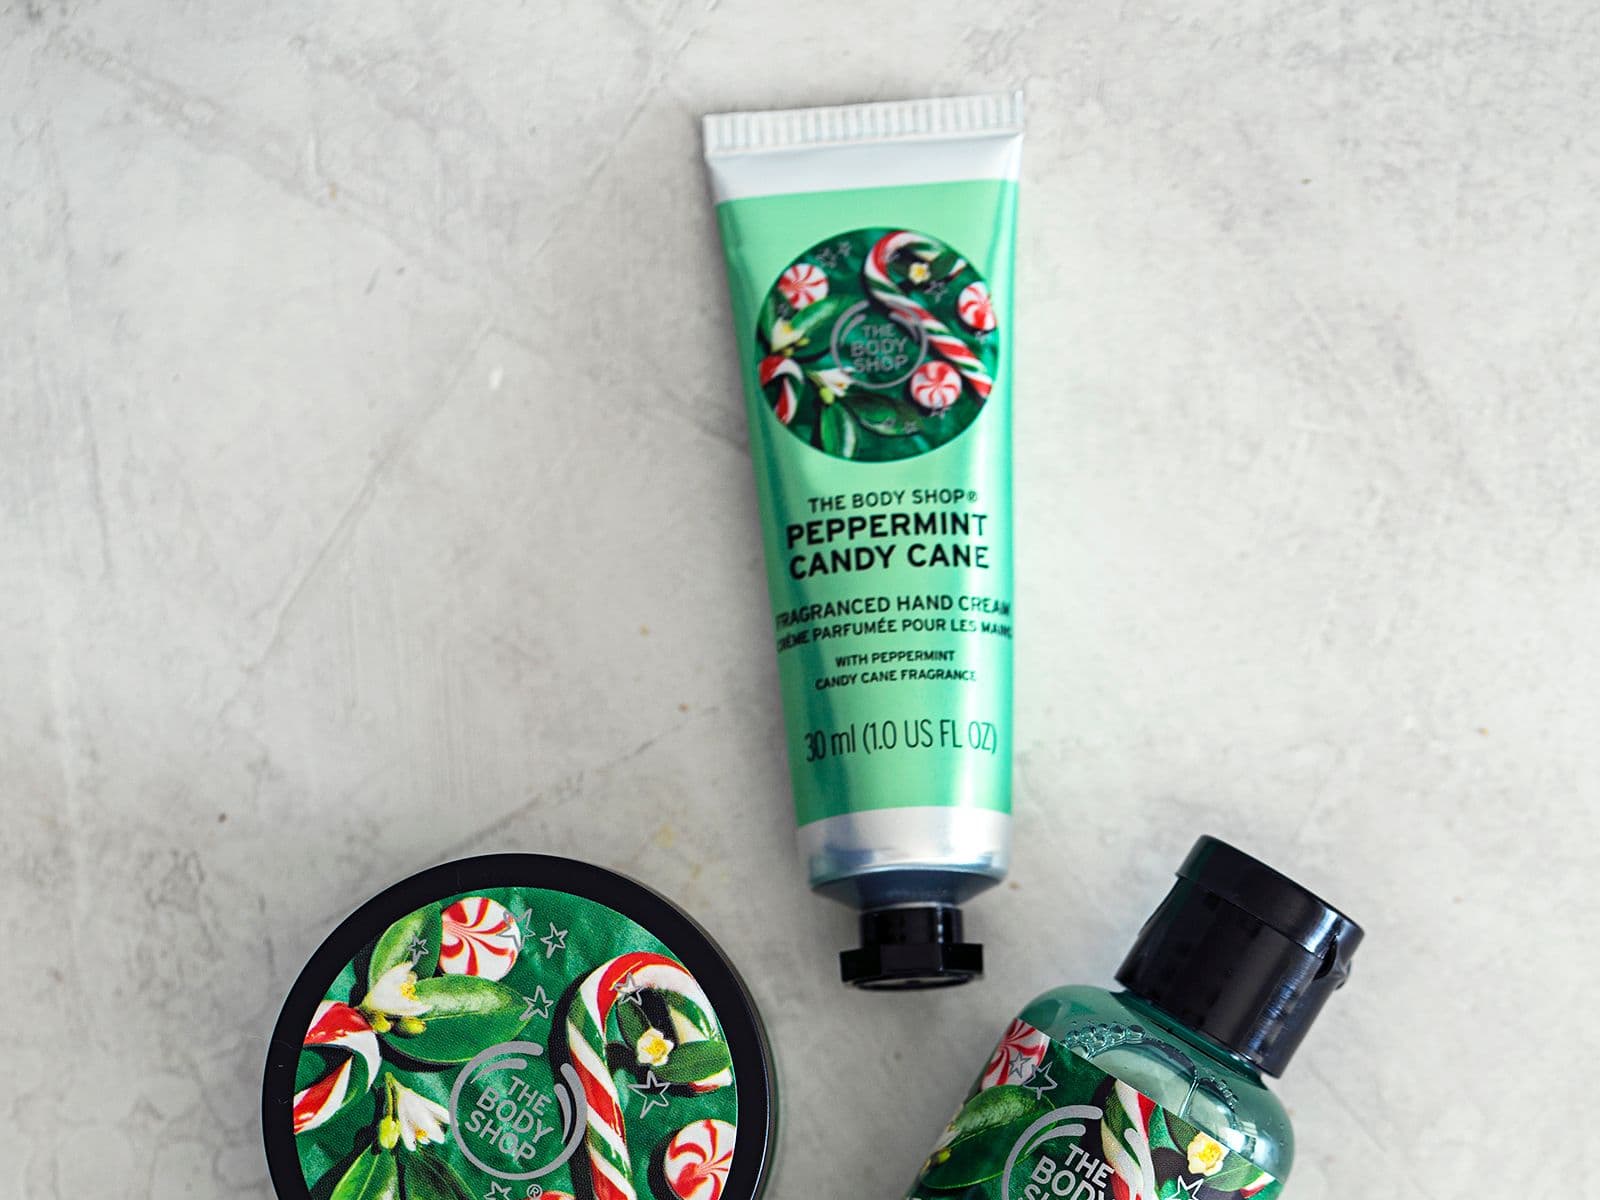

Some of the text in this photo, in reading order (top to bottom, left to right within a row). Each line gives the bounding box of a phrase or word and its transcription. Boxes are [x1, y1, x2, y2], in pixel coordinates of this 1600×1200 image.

[862, 322, 896, 337] THE
[851, 336, 908, 357] BODY
[853, 353, 909, 372] SHOP
[808, 497, 846, 513] THE
[852, 490, 906, 509] BODY
[785, 511, 988, 549] PEPPERMINT
[789, 543, 990, 580] CANDY CANE
[897, 595, 953, 611] HAND
[812, 618, 897, 641] PARFUMÉE
[902, 618, 946, 632] POUR
[951, 619, 977, 632] LES
[835, 650, 955, 667] WITH PEPPERMINT
[815, 669, 977, 690] CANDY CANE FRAGRANCE
[804, 719, 998, 762] 30 ml (1.0 US FL OZ)
[507, 1075, 552, 1116] THE
[476, 1086, 554, 1144] BODY
[464, 1110, 536, 1161] SHOP
[1064, 1143, 1115, 1189] THE
